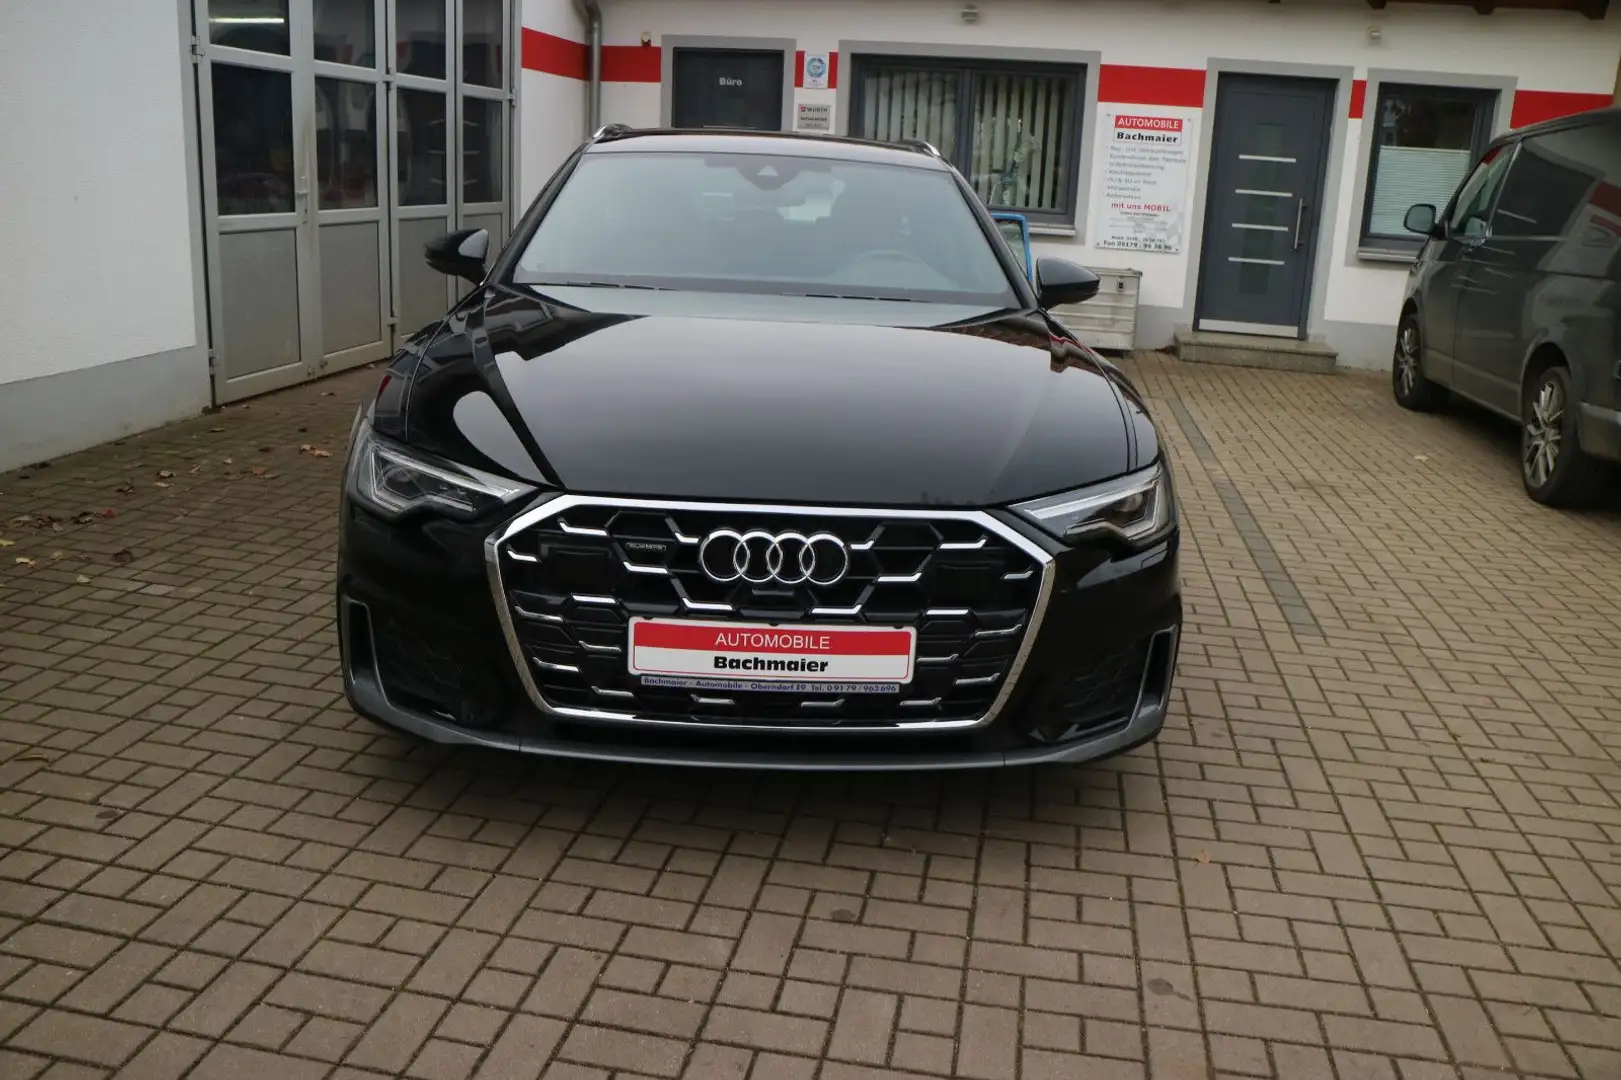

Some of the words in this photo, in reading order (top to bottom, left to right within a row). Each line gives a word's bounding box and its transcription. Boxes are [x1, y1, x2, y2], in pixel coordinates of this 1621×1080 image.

[719, 76, 742, 86] Büro
[1117, 117, 1179, 129] AUTOMOBILE
[1116, 131, 1178, 143] Bachmaier
[1143, 204, 1171, 212] MOBIL
[715, 632, 831, 650] AUTOMOBILE
[713, 655, 829, 672] Bachmaier
[644, 677, 687, 687] Bachmaier
[695, 680, 742, 690] Automobile
[750, 682, 794, 691] Oberndorf
[811, 683, 824, 692] Tel.
